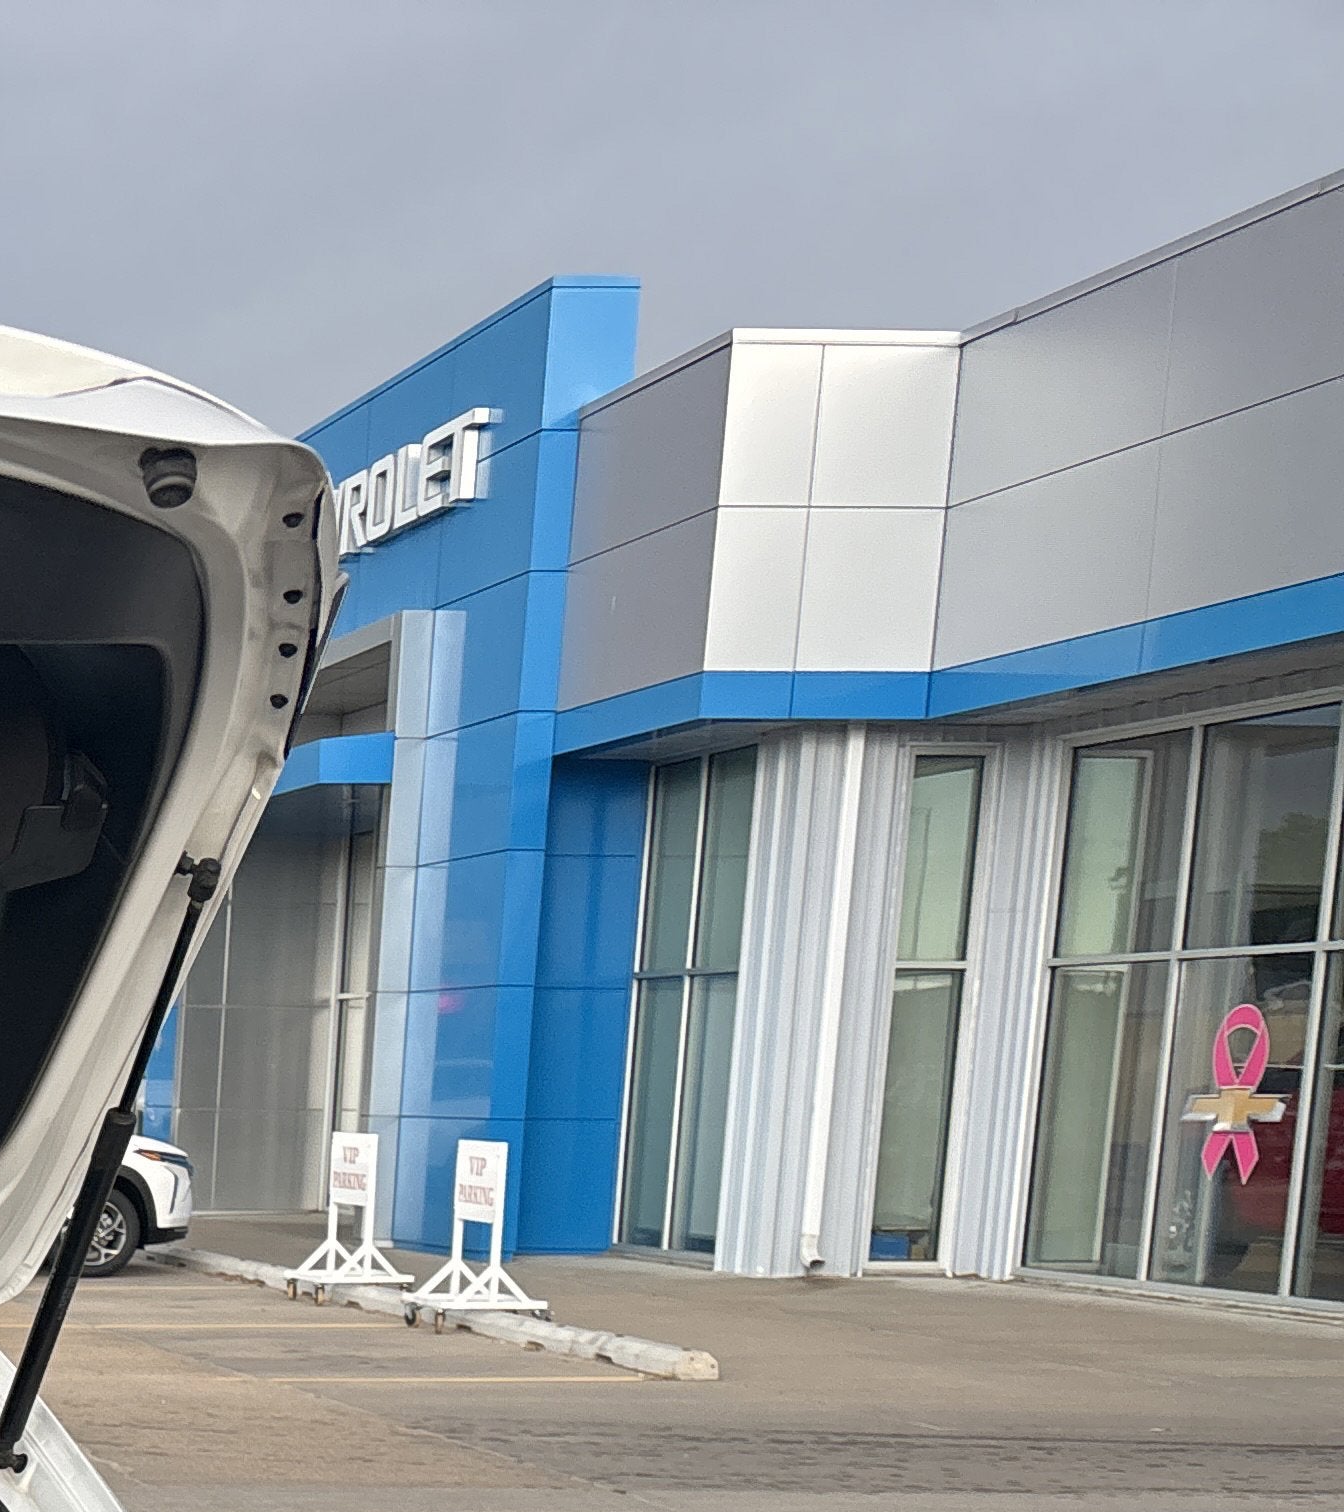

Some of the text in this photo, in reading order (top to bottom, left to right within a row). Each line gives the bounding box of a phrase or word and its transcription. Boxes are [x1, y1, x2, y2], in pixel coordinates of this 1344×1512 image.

[343, 1146, 359, 1164] VIP
[469, 1156, 487, 1176] VIP
[332, 1170, 367, 1191] PARKING
[458, 1183, 494, 1207] PARKING
